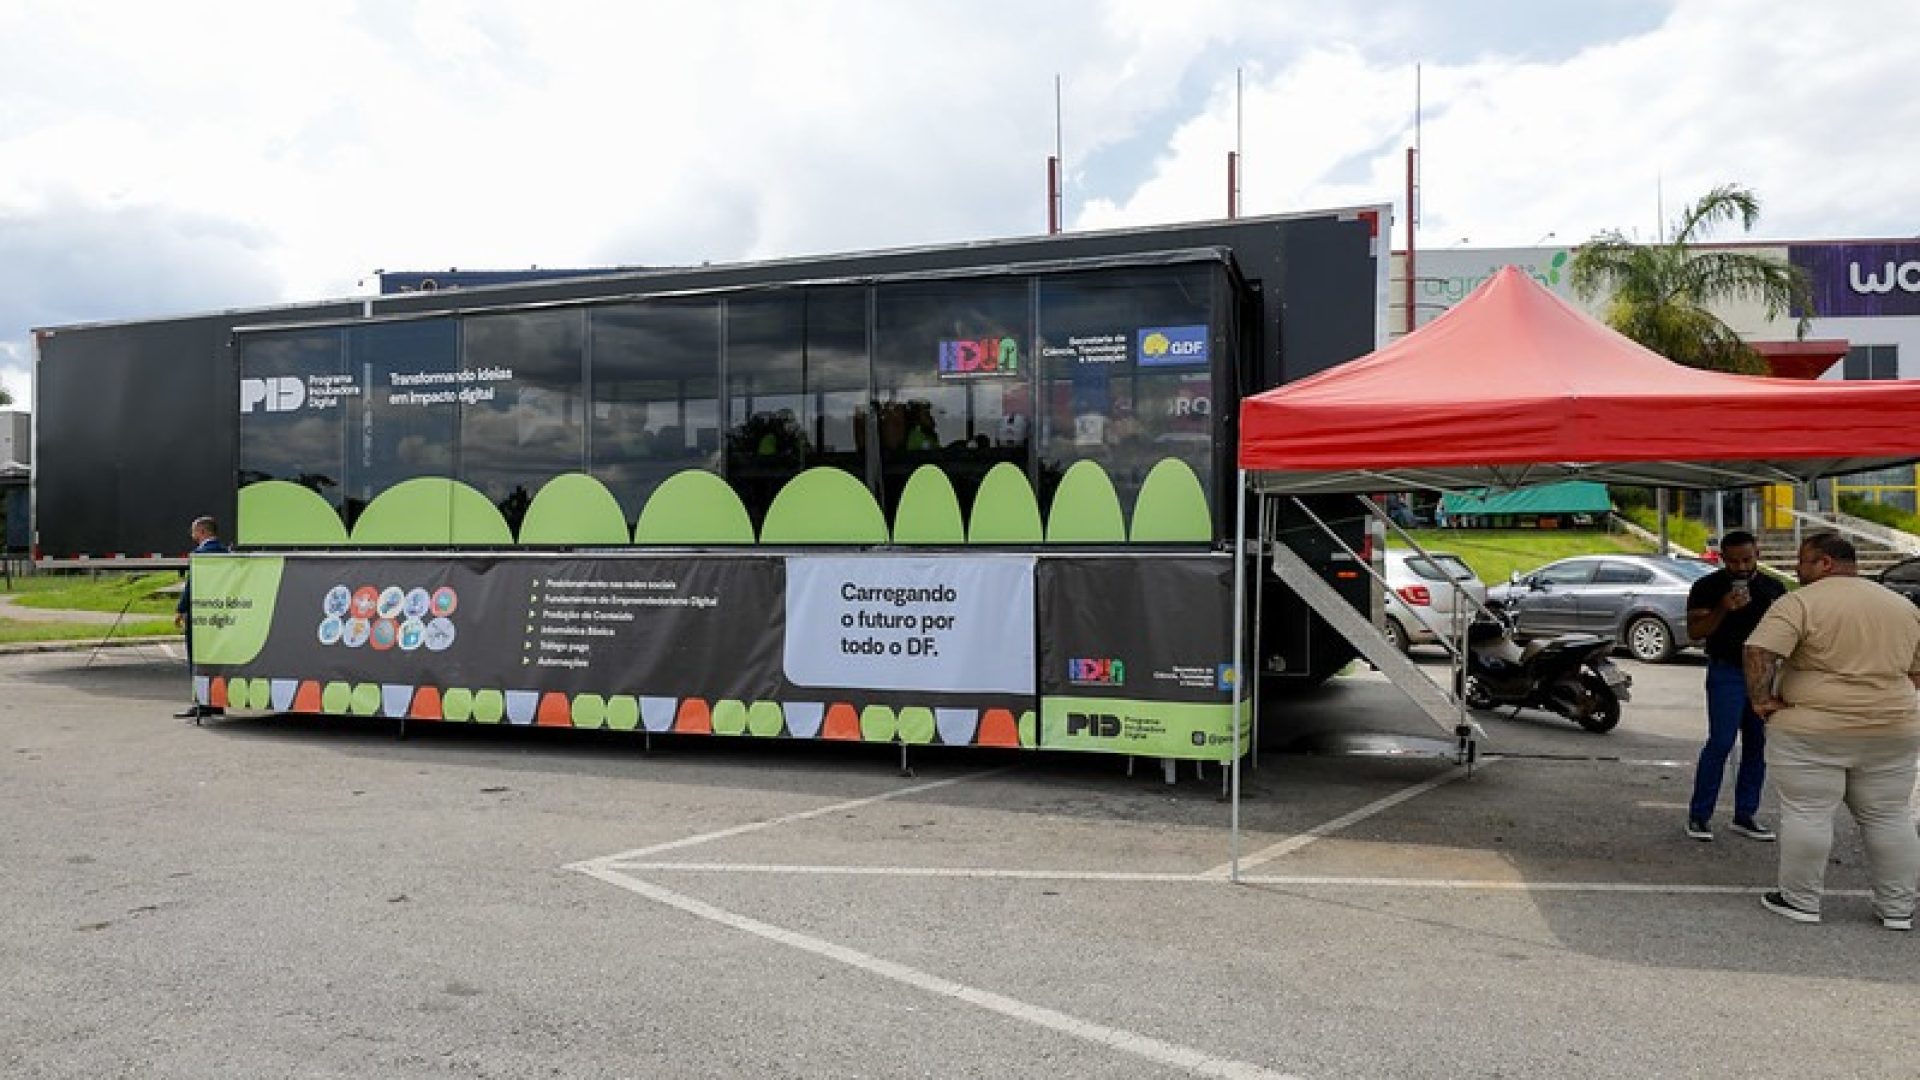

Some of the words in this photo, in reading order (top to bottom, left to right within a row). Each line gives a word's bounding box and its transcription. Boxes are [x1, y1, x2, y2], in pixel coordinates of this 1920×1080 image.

[240, 377, 305, 412] PID
[389, 393, 408, 404] em
[459, 386, 493, 404] digital
[841, 581, 957, 606] Carregando
[841, 613, 854, 628] o
[858, 610, 917, 628] futuro
[922, 615, 955, 634] por
[841, 637, 884, 655] todo
[889, 641, 902, 655] o
[907, 637, 938, 657] DF.
